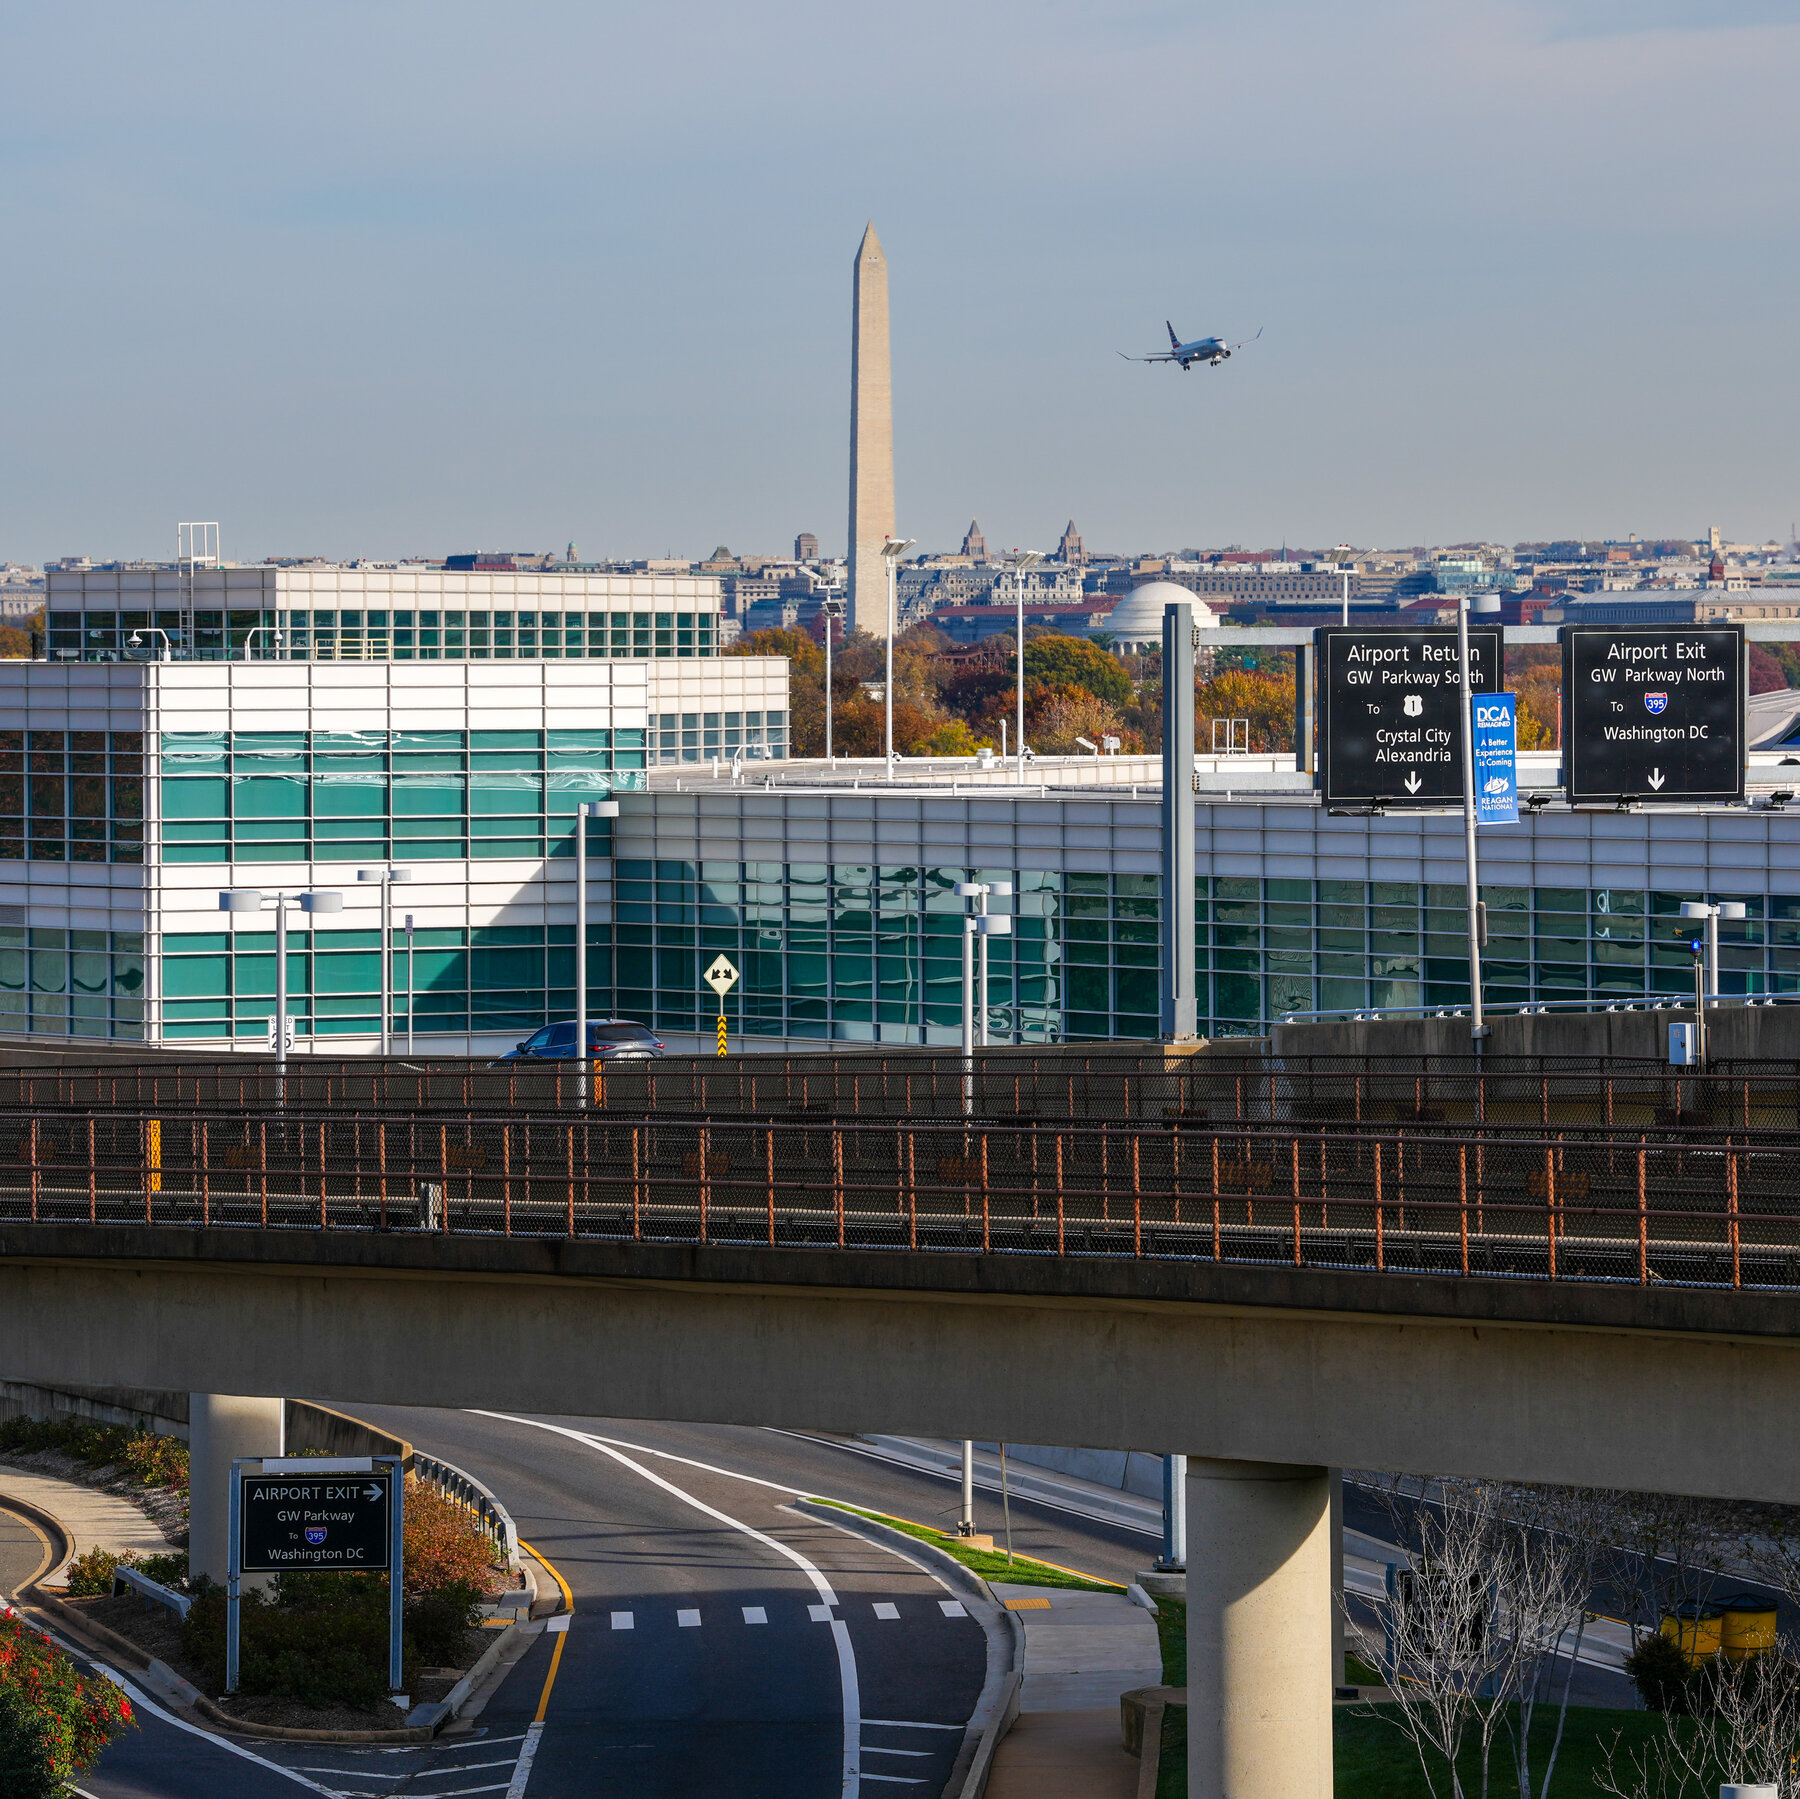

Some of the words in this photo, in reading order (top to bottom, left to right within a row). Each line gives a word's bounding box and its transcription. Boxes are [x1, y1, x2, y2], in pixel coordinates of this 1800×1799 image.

[1347, 645, 1410, 665] Airport
[1423, 645, 1480, 662] Retun
[1607, 643, 1668, 663] Airport
[1677, 642, 1706, 659] Exit
[1347, 671, 1374, 684] GW
[1382, 670, 1441, 687] Parkway
[1445, 670, 1484, 684] Soth
[1591, 669, 1617, 682] GW
[1626, 668, 1683, 684] Parkway
[1688, 667, 1725, 682] North
[1367, 704, 1380, 715] To
[1611, 702, 1624, 712] To
[1648, 700, 1665, 709] 395
[1477, 706, 1510, 722] DCA
[1376, 728, 1421, 746] Crystal
[1426, 729, 1452, 745] City
[1604, 726, 1685, 742] Washington
[1690, 726, 1709, 738] DC
[1376, 748, 1451, 762] Alexandria
[1476, 749, 1513, 757] Experience
[1487, 758, 1512, 767] Coming
[1481, 796, 1513, 805] REAGAN
[252, 1487, 321, 1501] AIRPORT
[326, 1487, 360, 1500] EXIT
[277, 1511, 301, 1522] GW
[304, 1510, 355, 1524] Parkway
[288, 1532, 299, 1540] To
[308, 1532, 324, 1541] 395
[267, 1549, 343, 1562] Washington
[347, 1548, 364, 1559] DC
